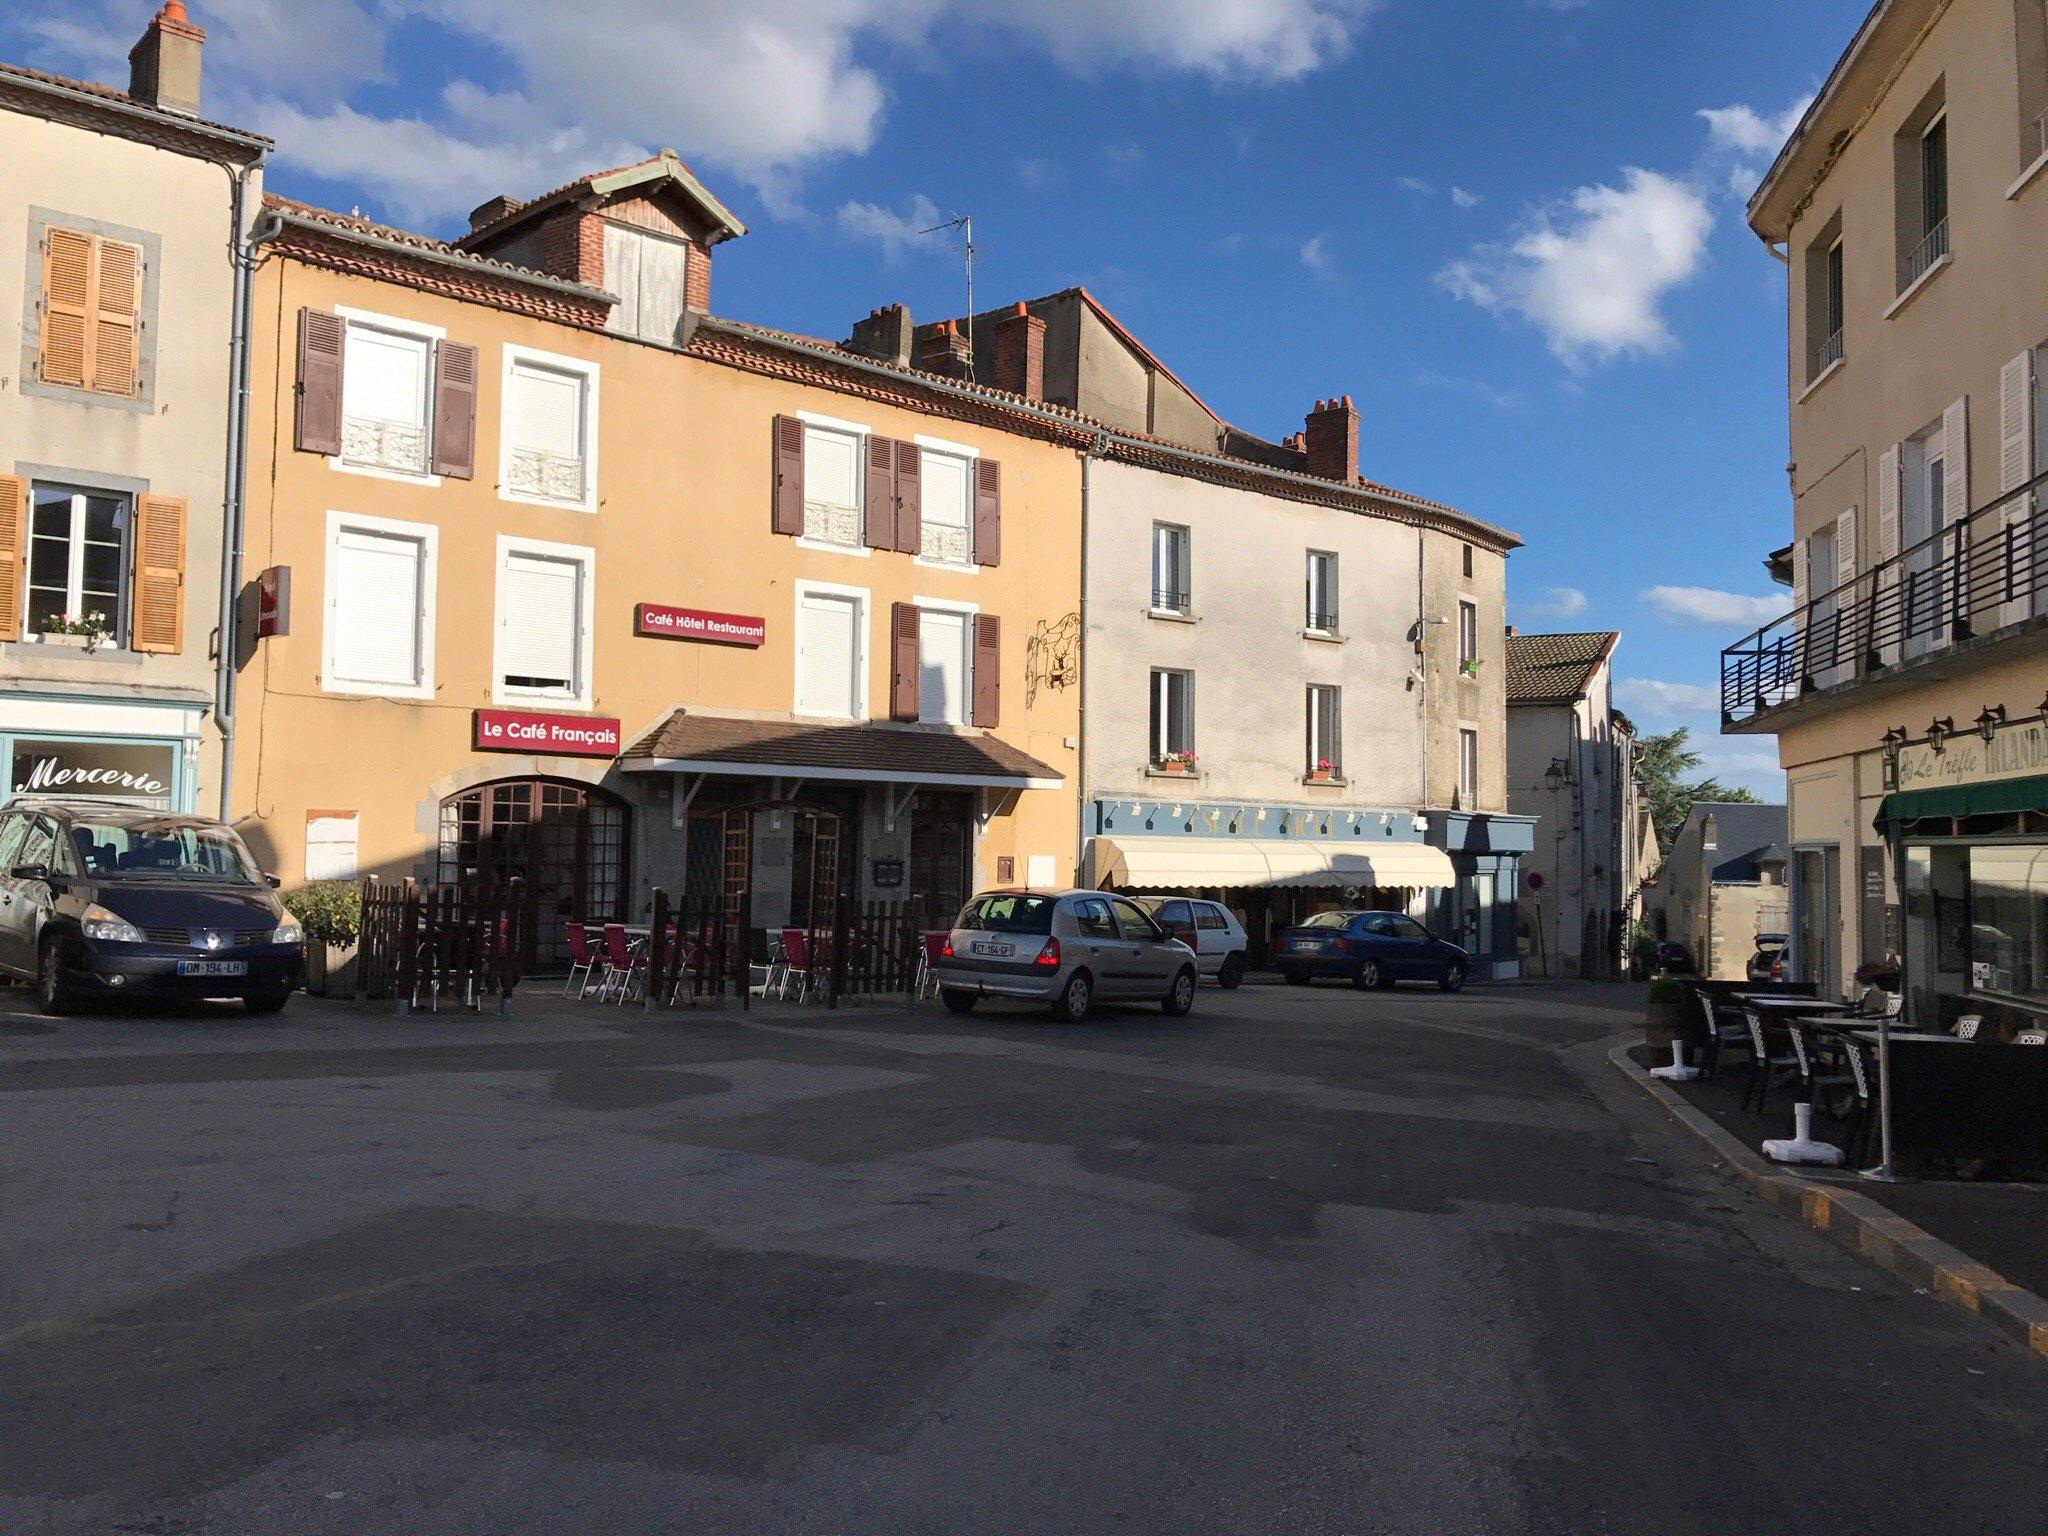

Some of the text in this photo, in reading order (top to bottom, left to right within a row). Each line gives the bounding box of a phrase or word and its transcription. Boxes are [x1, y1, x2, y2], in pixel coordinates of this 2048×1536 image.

[645, 612, 764, 636] Café Hôtel Restaurant
[484, 721, 616, 745] Le Café Français
[16, 757, 169, 794] Mercerie
[1914, 752, 1932, 779] Le
